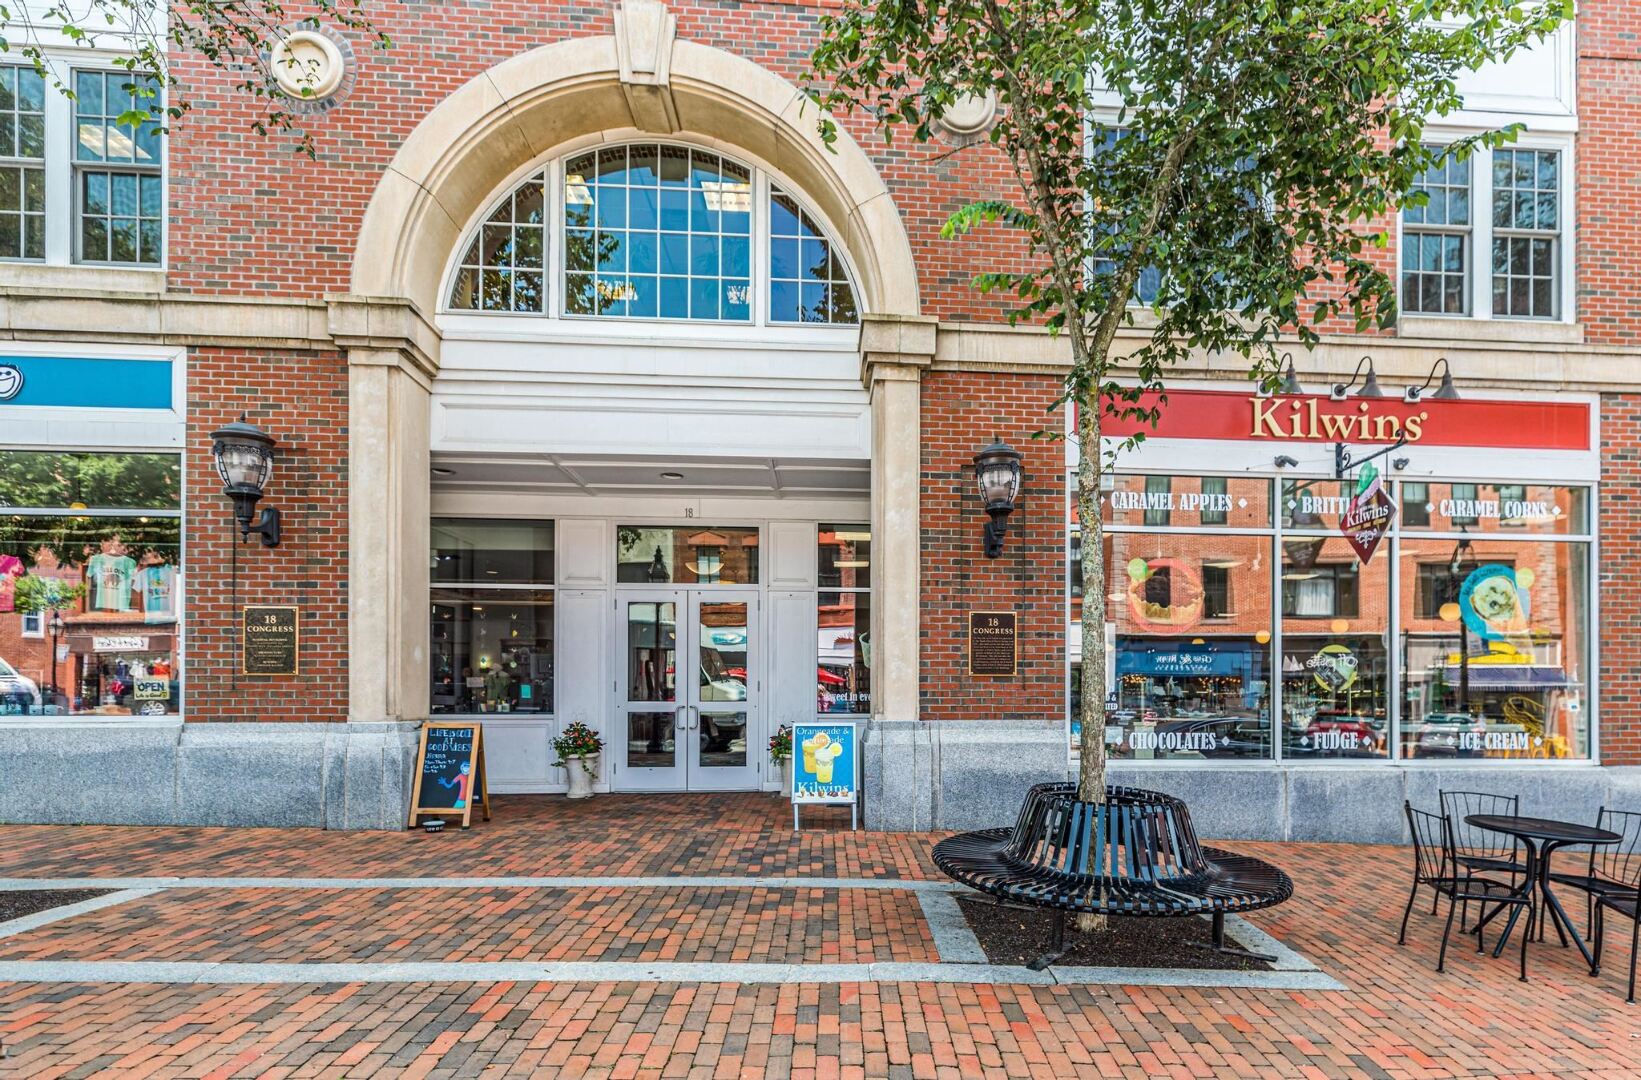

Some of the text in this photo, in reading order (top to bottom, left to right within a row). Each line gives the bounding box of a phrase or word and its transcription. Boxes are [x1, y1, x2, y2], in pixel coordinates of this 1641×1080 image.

[1111, 491, 1233, 512] CARAMEL APPLES
[685, 508, 694, 518] 18
[1439, 500, 1548, 519] CARAMEL CORNS
[1347, 504, 1389, 528] Kilwins
[264, 615, 277, 624] 18
[988, 617, 999, 627] 18
[246, 625, 294, 633] CONGRESS
[973, 627, 1014, 635] CONGRESS
[137, 682, 165, 692] OPEN
[843, 727, 849, 735] &
[444, 737, 454, 745] AT
[1128, 732, 1217, 750] CHOCOLATES
[1313, 732, 1359, 750] FUDGE
[1459, 732, 1529, 750] ICE CREAM
[427, 743, 449, 751] GOOD
[797, 781, 849, 792] Kilwins
